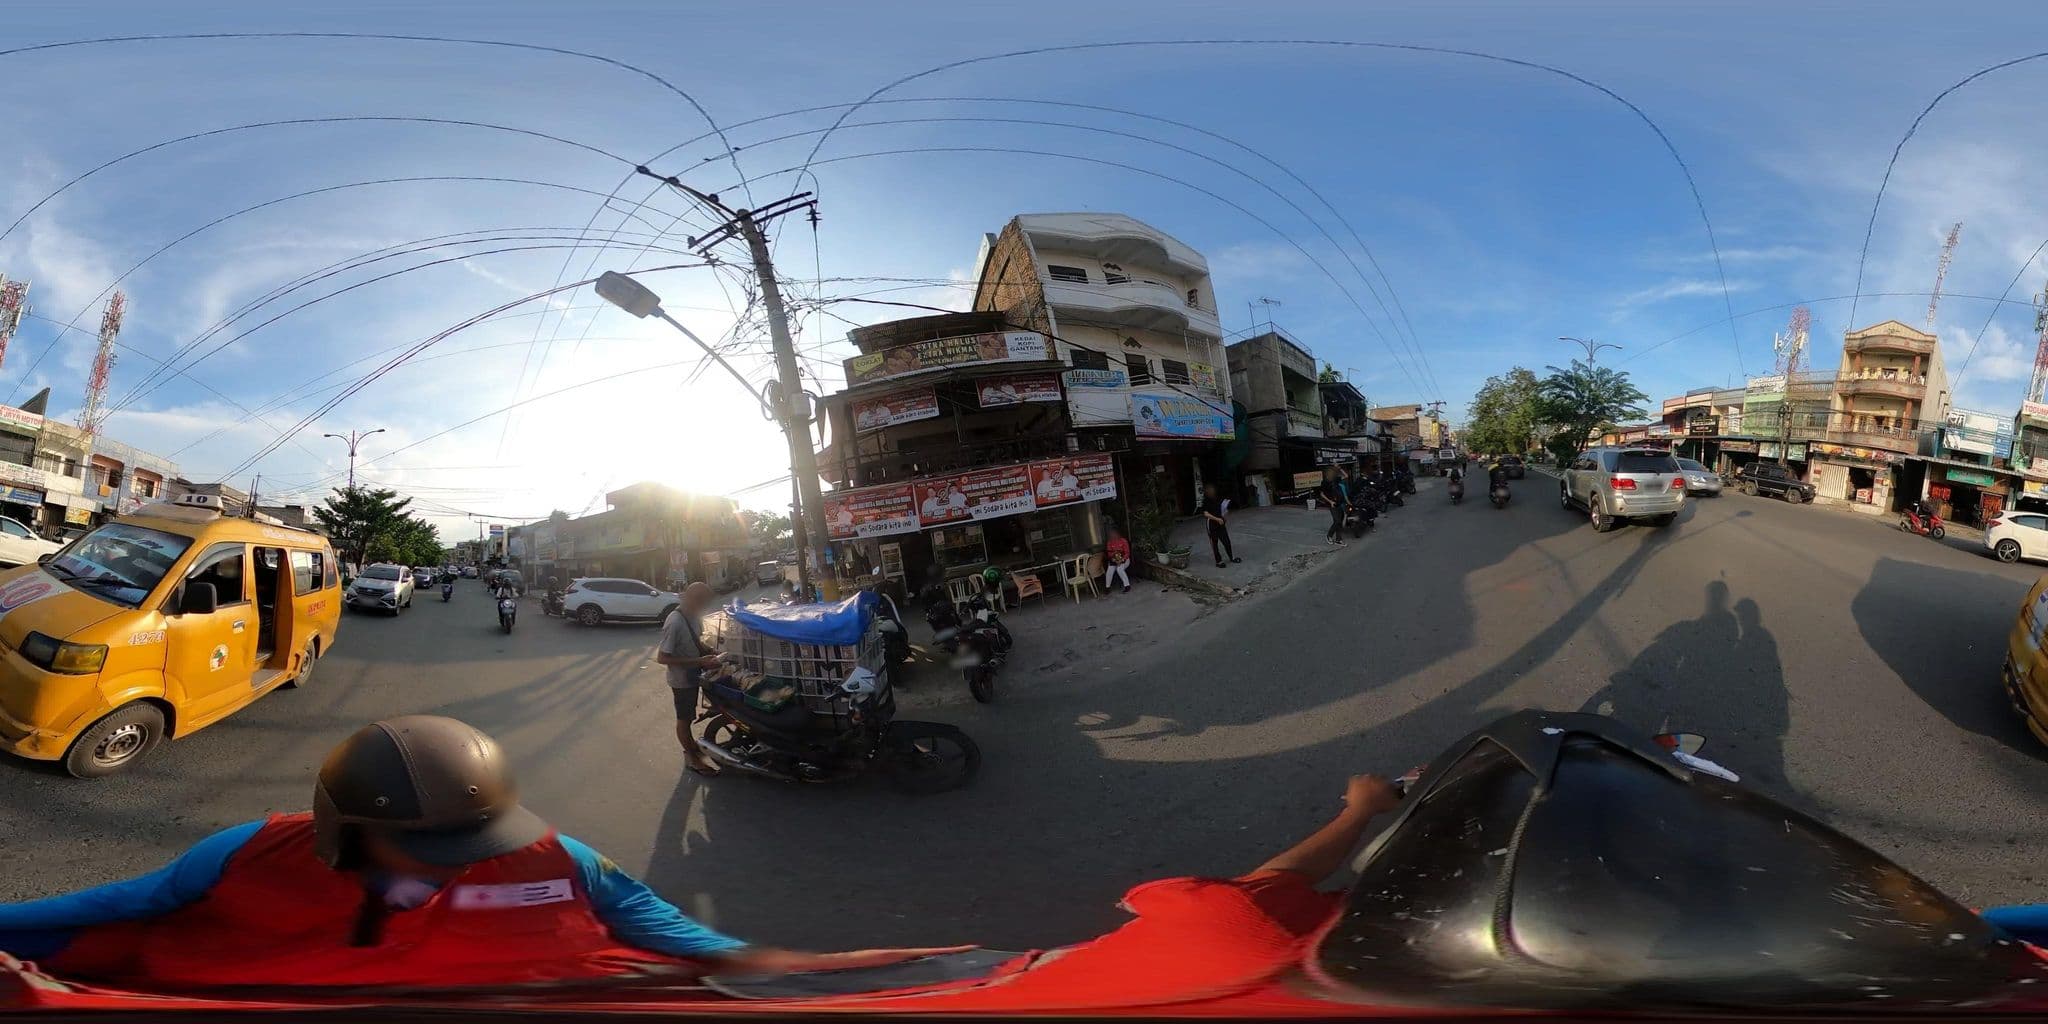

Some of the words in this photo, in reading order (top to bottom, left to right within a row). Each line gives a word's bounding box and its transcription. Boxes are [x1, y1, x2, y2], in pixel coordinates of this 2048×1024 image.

[916, 340, 944, 352] EXTRA
[947, 336, 976, 347] HALUS
[918, 349, 943, 360] EXTRA
[185, 495, 208, 504] 10
